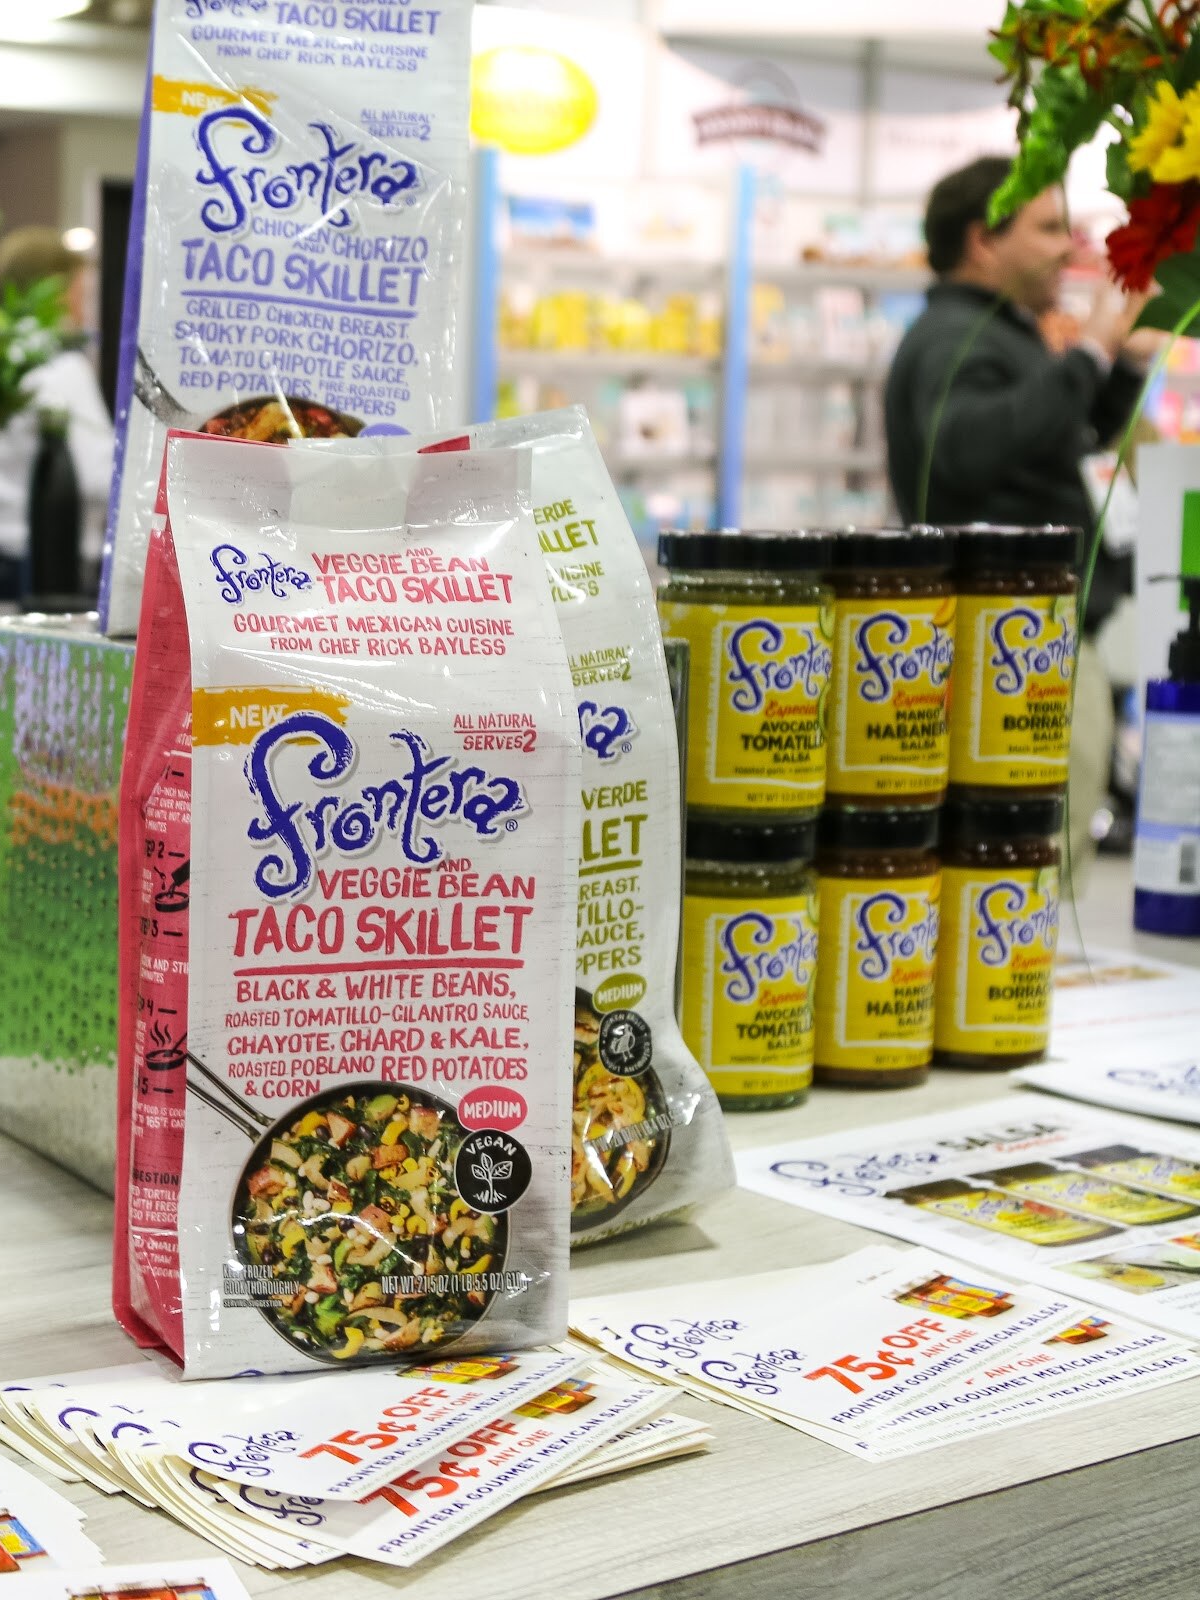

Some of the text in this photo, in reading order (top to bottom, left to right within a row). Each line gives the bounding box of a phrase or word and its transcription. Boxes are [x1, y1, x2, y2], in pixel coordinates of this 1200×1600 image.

[276, 4, 441, 35] TACO SKILLET
[333, 234, 429, 262] CHORIZO
[181, 239, 424, 307] TACO SKILLET
[311, 547, 489, 575] VEGGIE AND BEAN
[316, 575, 513, 603] TACO SKILLET
[234, 613, 514, 635] GOURMET MEXICAN CUISINE
[271, 637, 506, 655] FROM CHEF RICK BAYLESS
[229, 704, 289, 728] NEW
[454, 713, 535, 728] ALL NATURAL
[463, 733, 523, 750] SERVES
[581, 780, 648, 810] VERDE
[318, 859, 535, 899] VEGGIE AND BEAN
[229, 902, 533, 957] TACO SKILLET
[237, 971, 516, 1002] BLACK & WHITE BEANS,
[598, 984, 644, 1003] MEDIUM
[225, 1010, 279, 1027] ROASTED
[284, 1004, 477, 1027] TOMATILLO-CILANTRO
[341, 1028, 424, 1051] CHARD
[431, 1032, 446, 1048] &
[451, 1027, 529, 1050] KALE,
[229, 1055, 528, 1082] ROASTED POBLANO RED POTATOES
[245, 1080, 320, 1098] & CORN
[464, 1100, 521, 1119] MEDIUM
[466, 1137, 517, 1156] VEGAN
[938, 1122, 1059, 1152] SALSA
[882, 1318, 950, 1348] OFF
[921, 1329, 978, 1359] ANY ONE
[832, 1302, 1069, 1424] FRONTERA GOURMET MEXICAN SALSAS
[383, 1387, 453, 1420] OFF
[425, 1392, 484, 1423] ANY ONE
[327, 1355, 576, 1494] FRONTERA GOURMET MEXICAN SALSAS
[447, 1418, 519, 1458] OFF
[489, 1429, 554, 1468] ANY ONE
[378, 1387, 654, 1554] FRONTERA GOURMET MEXICAN SALSAS
